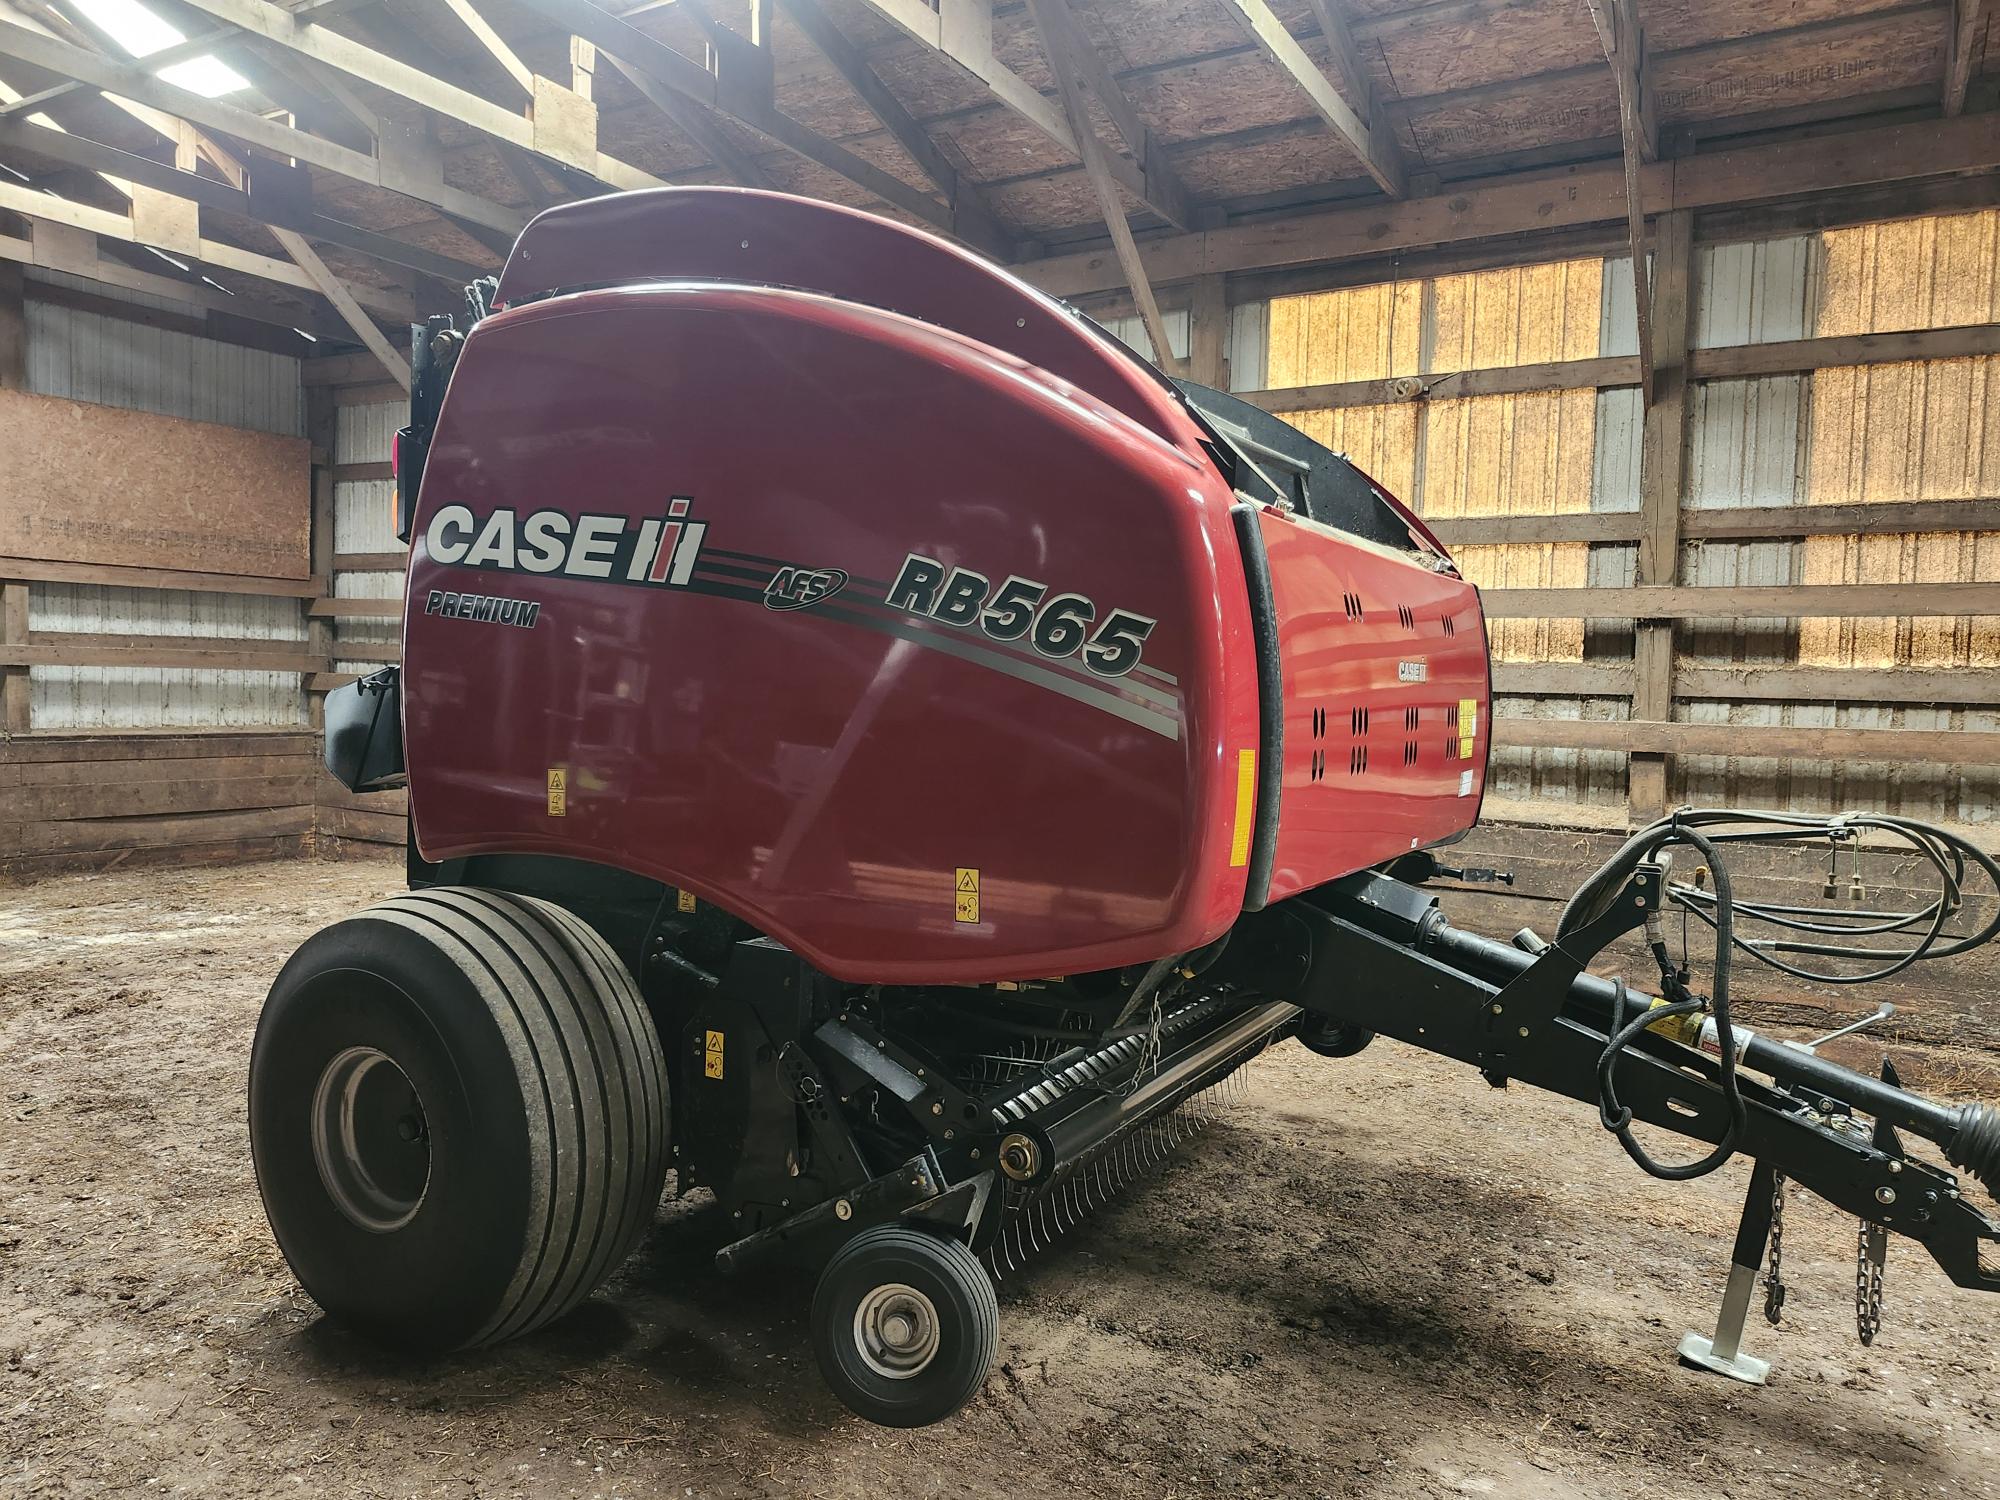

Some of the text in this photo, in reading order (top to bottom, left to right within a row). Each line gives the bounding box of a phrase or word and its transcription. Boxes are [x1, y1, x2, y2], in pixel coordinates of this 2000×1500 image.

[425, 504, 627, 579] CASE
[424, 589, 541, 629] PREMIUM
[764, 566, 831, 601] AFS
[885, 552, 1158, 677] RB565
